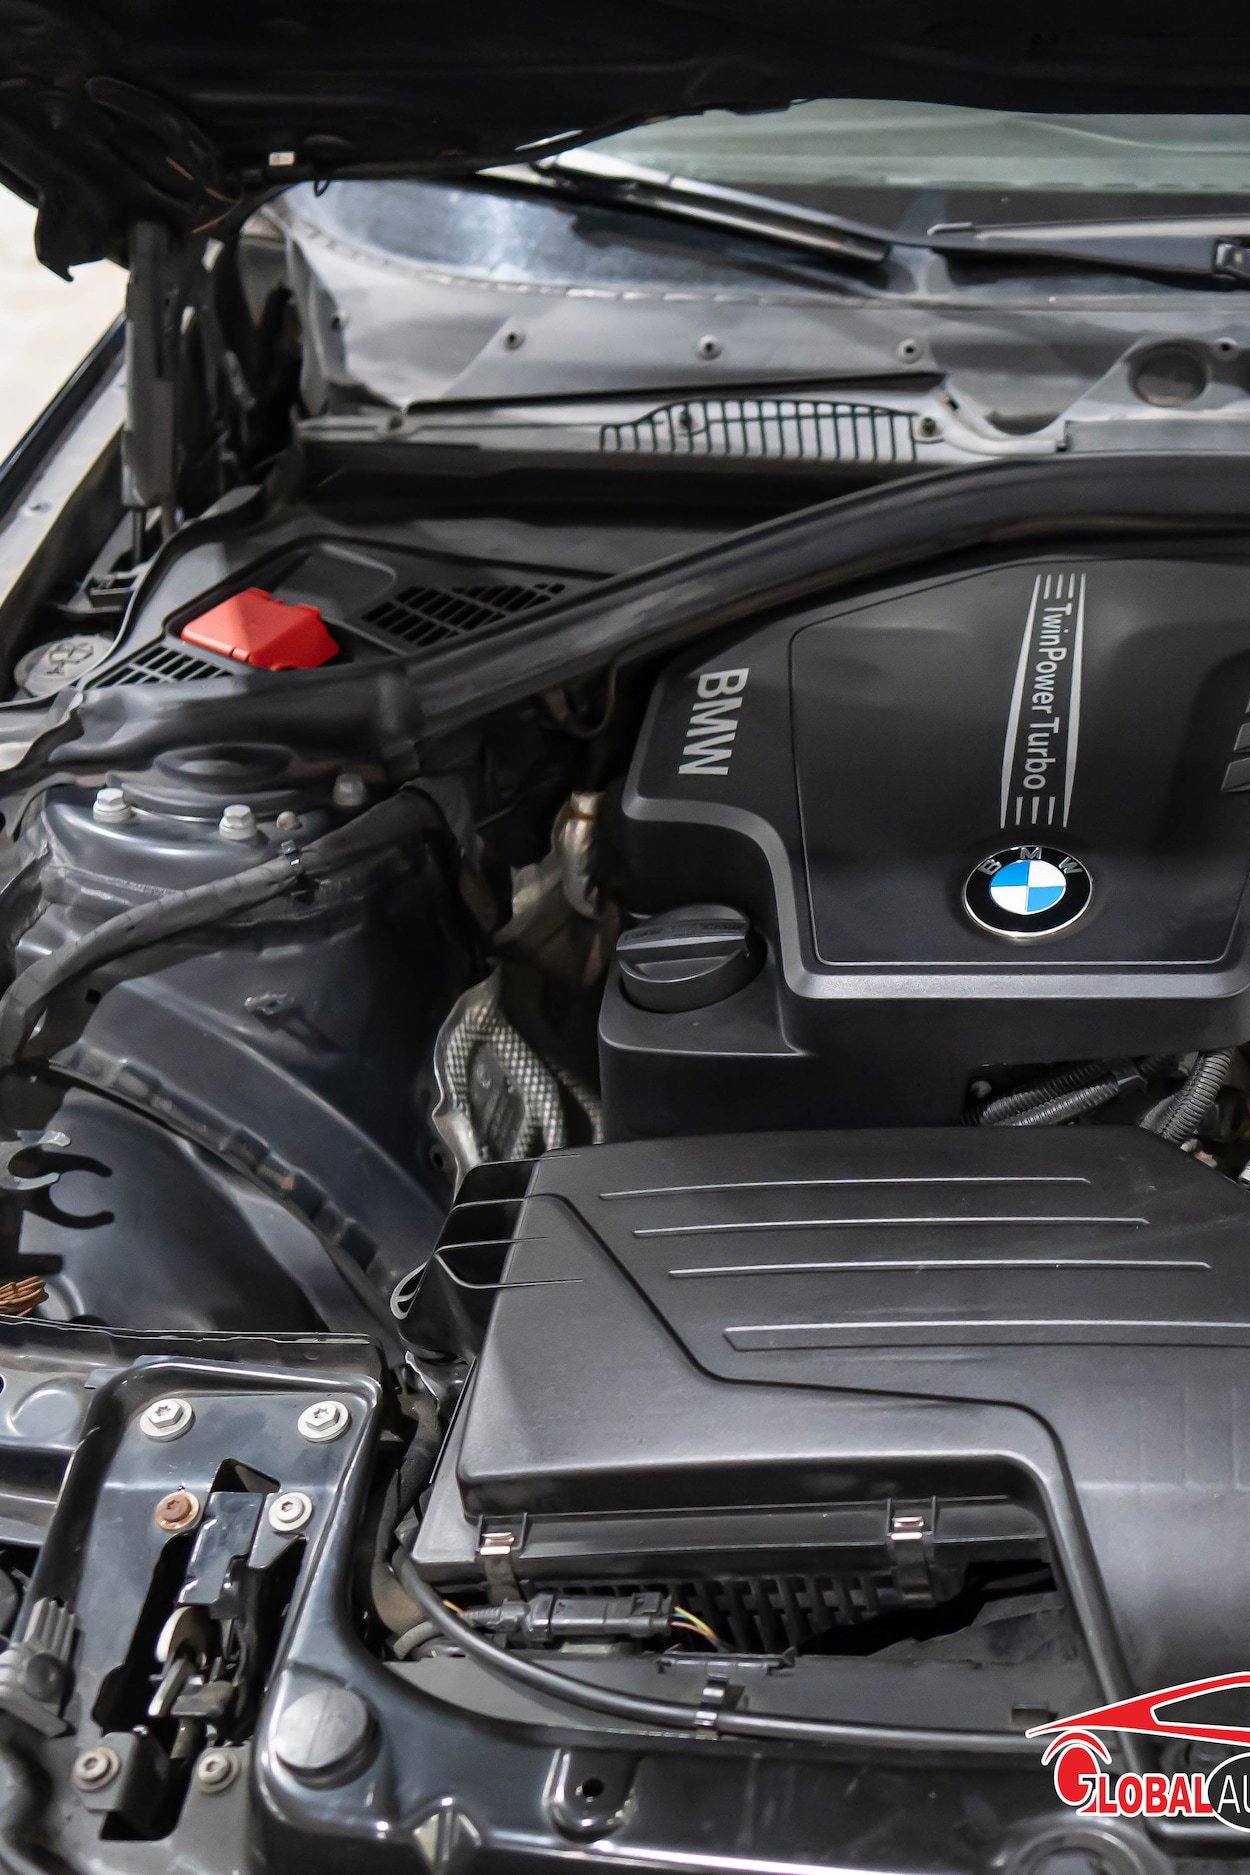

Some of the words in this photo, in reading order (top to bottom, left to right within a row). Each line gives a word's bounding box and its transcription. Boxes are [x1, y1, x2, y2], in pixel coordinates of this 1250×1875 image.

[1031, 603, 1072, 714] TwinPower
[678, 667, 749, 775] BMW
[1023, 717, 1059, 790] Turbo
[979, 846, 1083, 876] BMW
